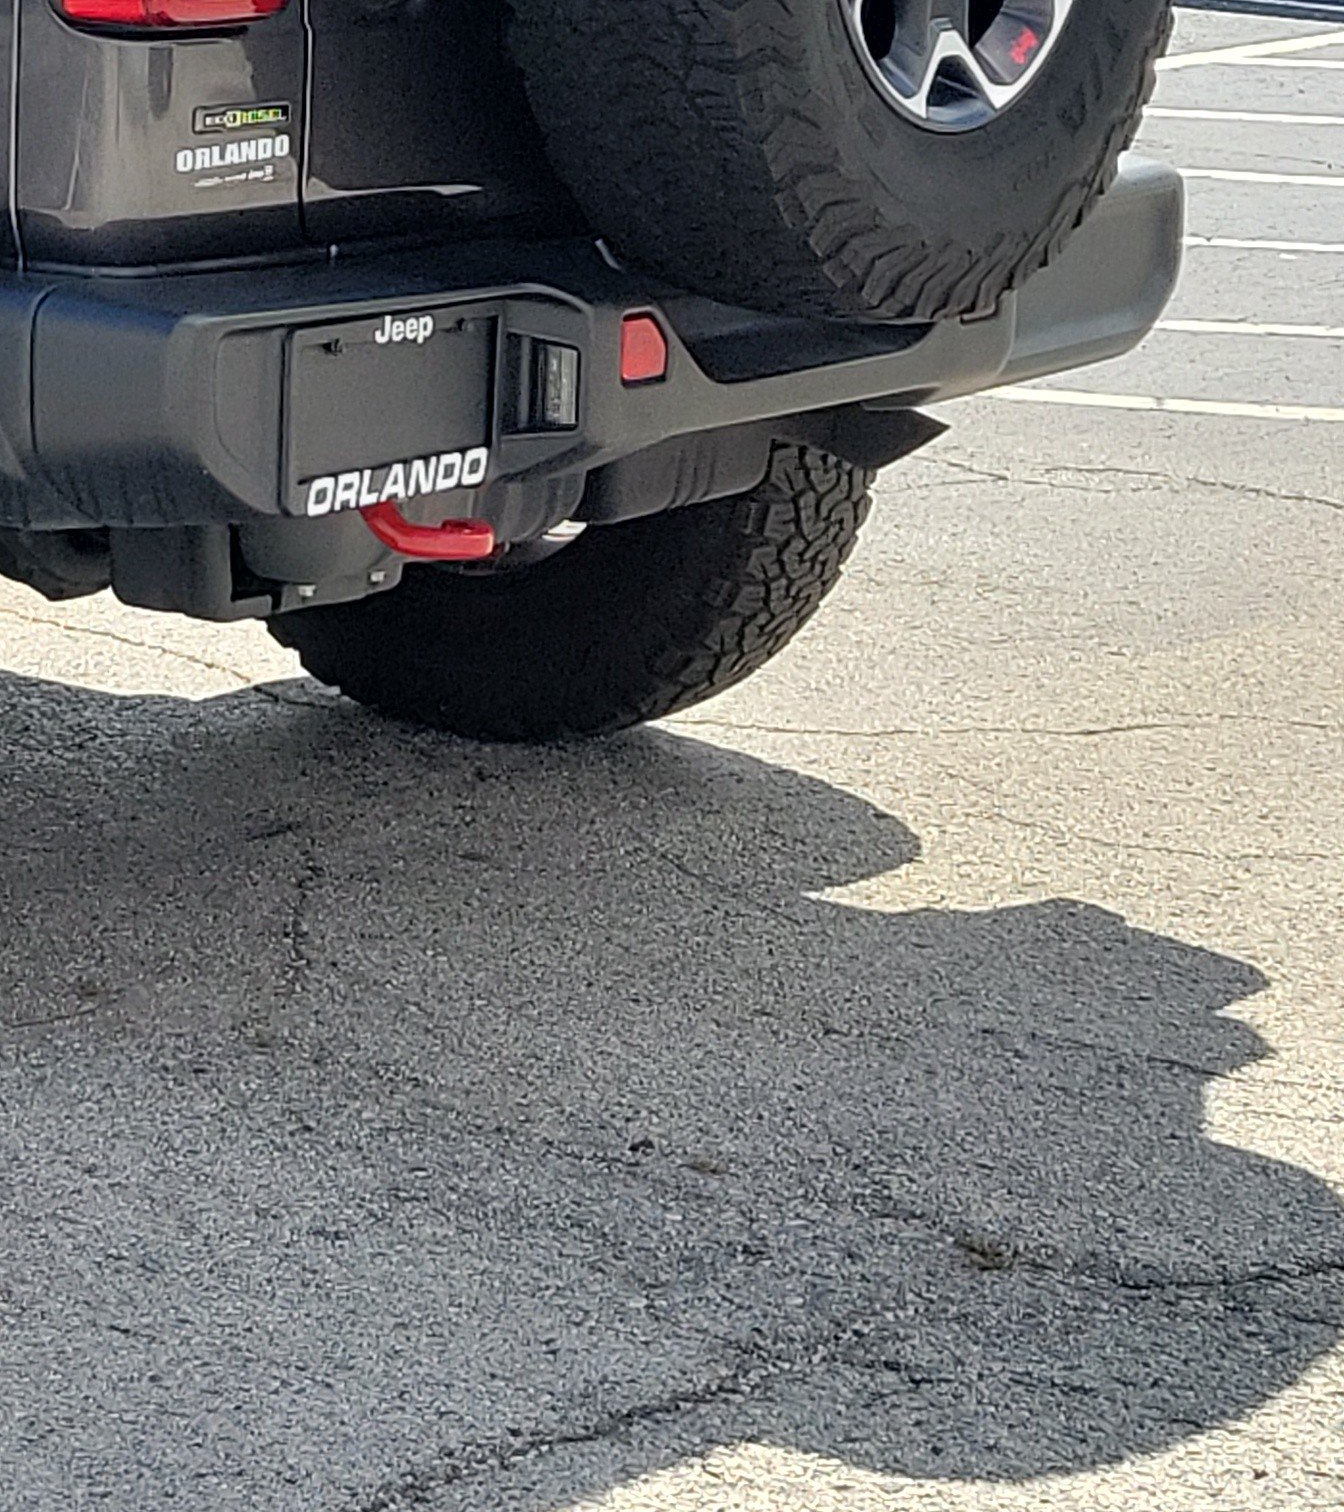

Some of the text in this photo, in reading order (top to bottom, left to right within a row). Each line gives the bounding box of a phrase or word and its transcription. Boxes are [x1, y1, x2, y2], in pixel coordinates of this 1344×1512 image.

[176, 134, 290, 172] ORLANDO
[374, 314, 433, 344] Jeep
[306, 446, 488, 517] ORLANDO
